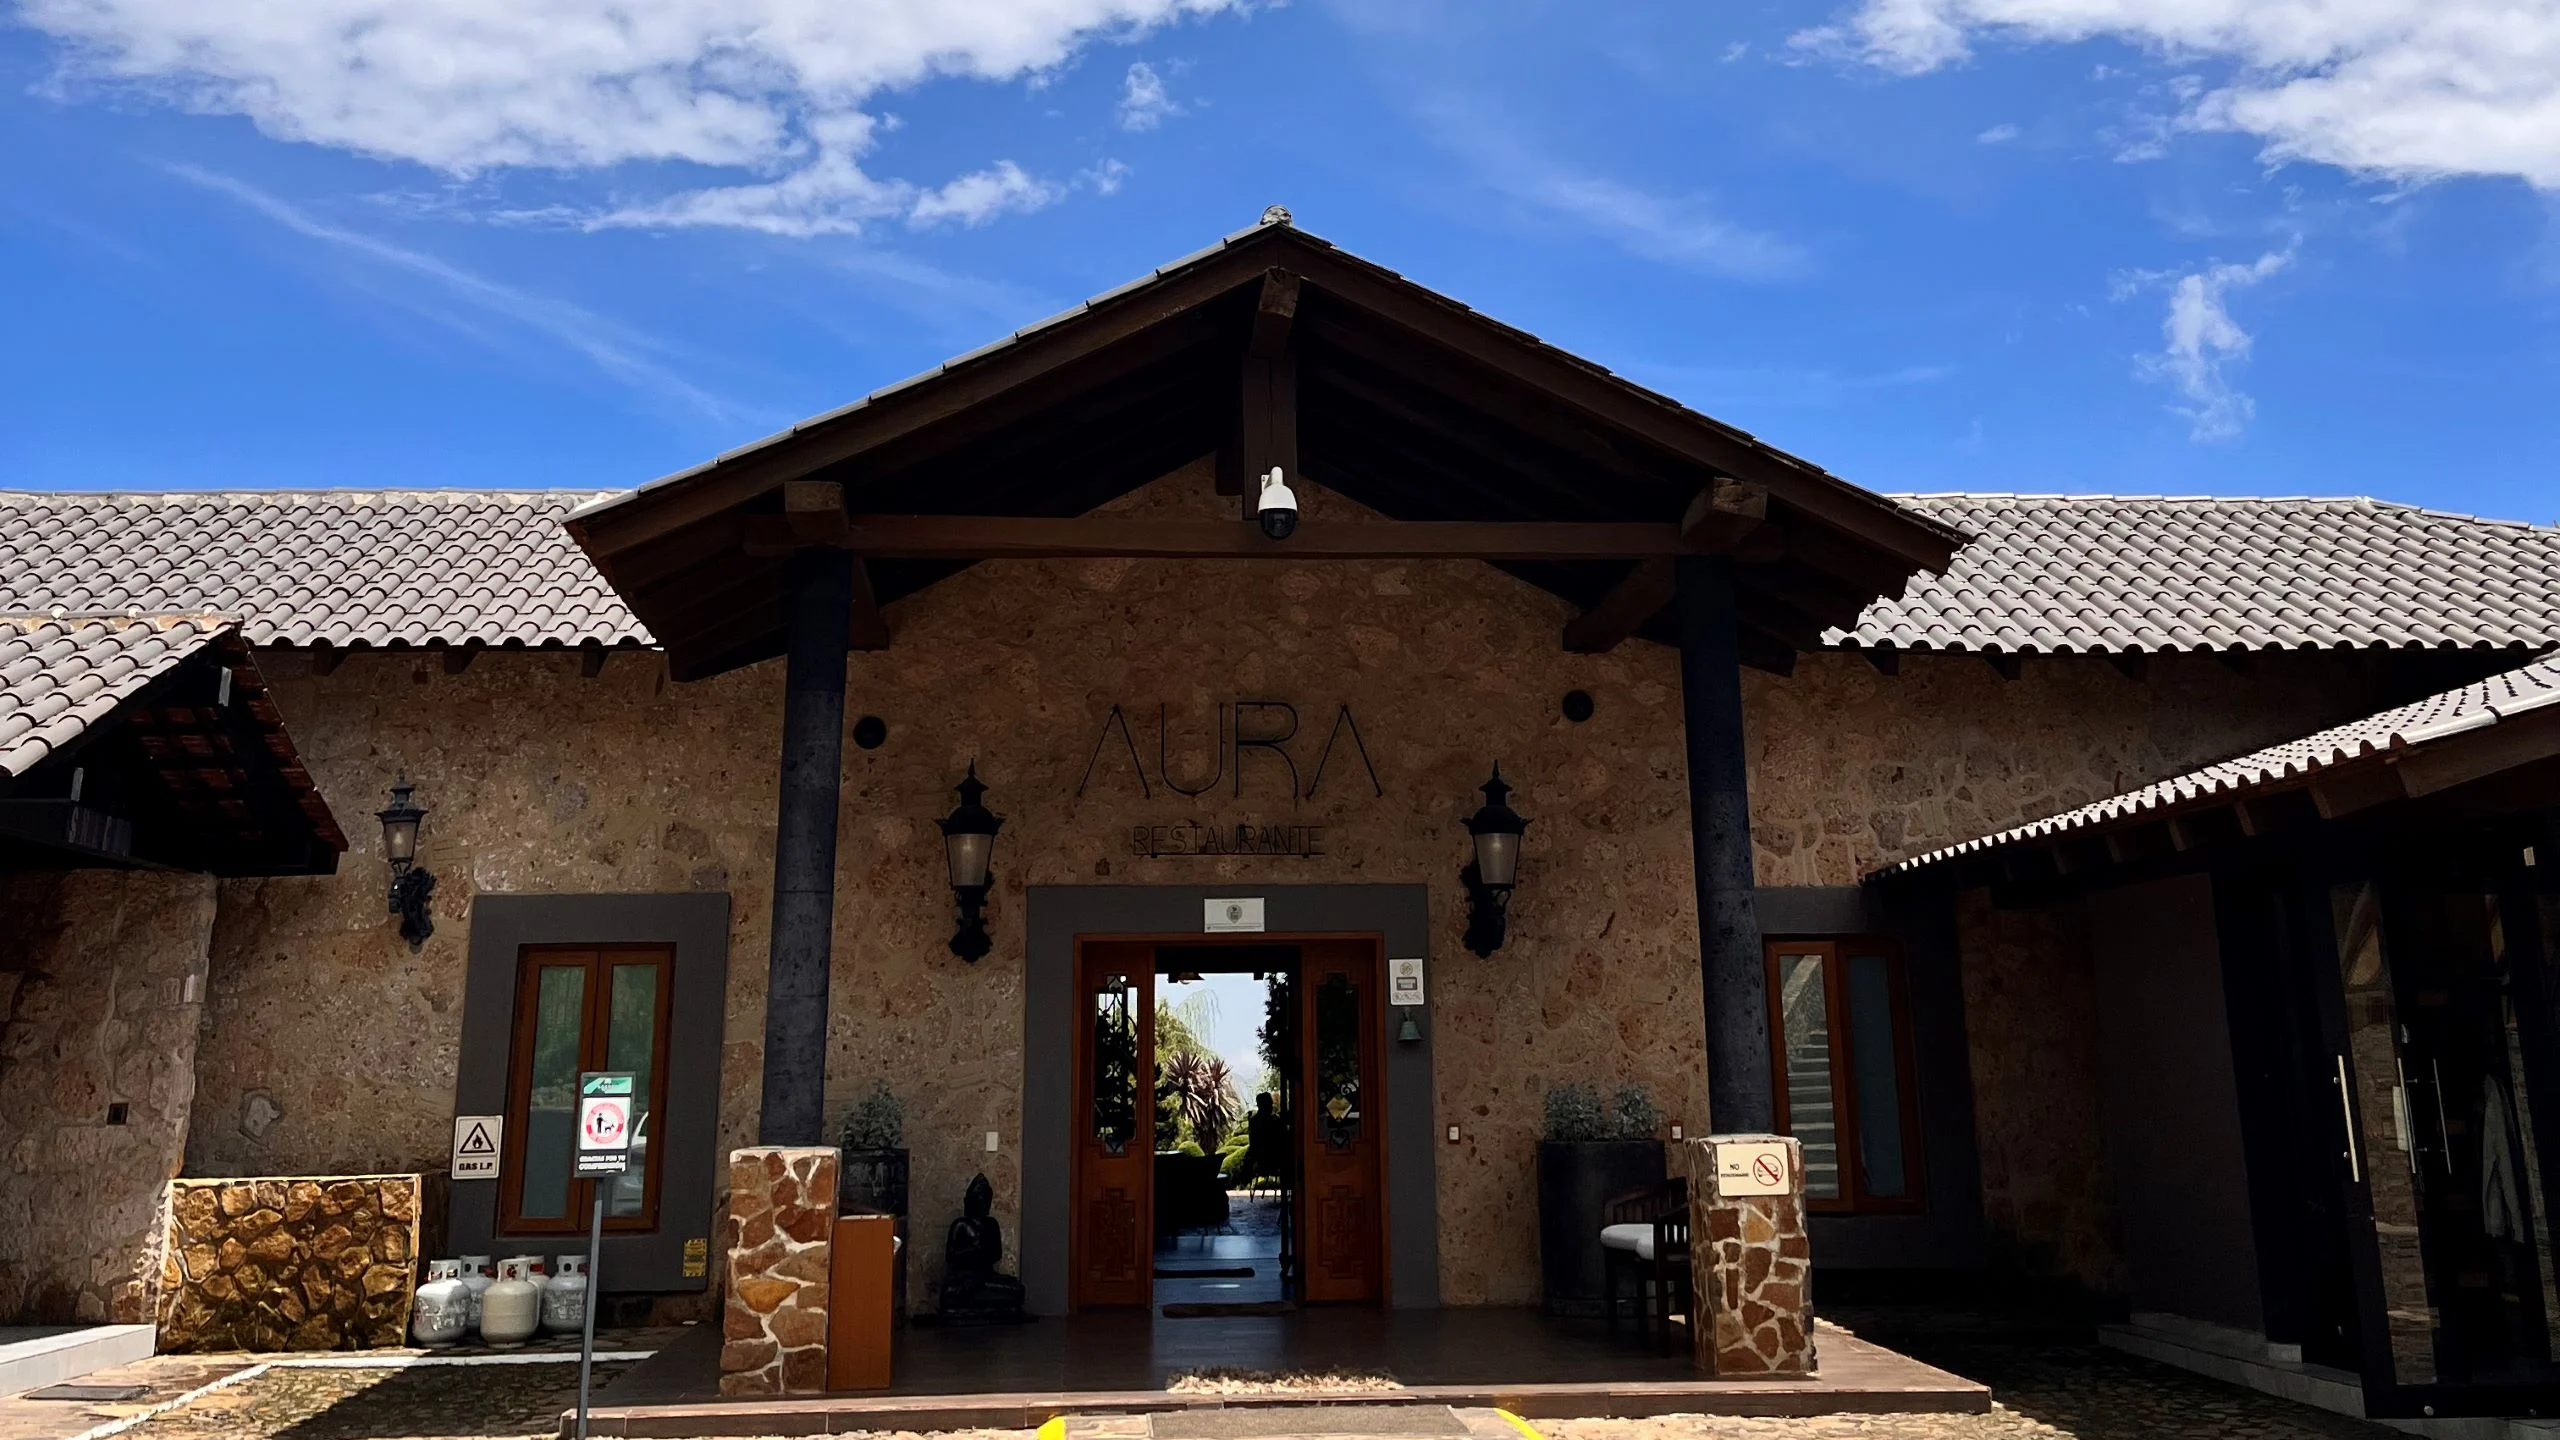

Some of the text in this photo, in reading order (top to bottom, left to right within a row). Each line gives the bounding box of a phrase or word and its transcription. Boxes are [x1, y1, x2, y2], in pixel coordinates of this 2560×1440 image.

[1076, 702, 1383, 800] AURA
[1132, 825, 1325, 856] RESTAURANTE
[459, 1162, 478, 1171] GAS
[1730, 1163, 1740, 1171] NO
